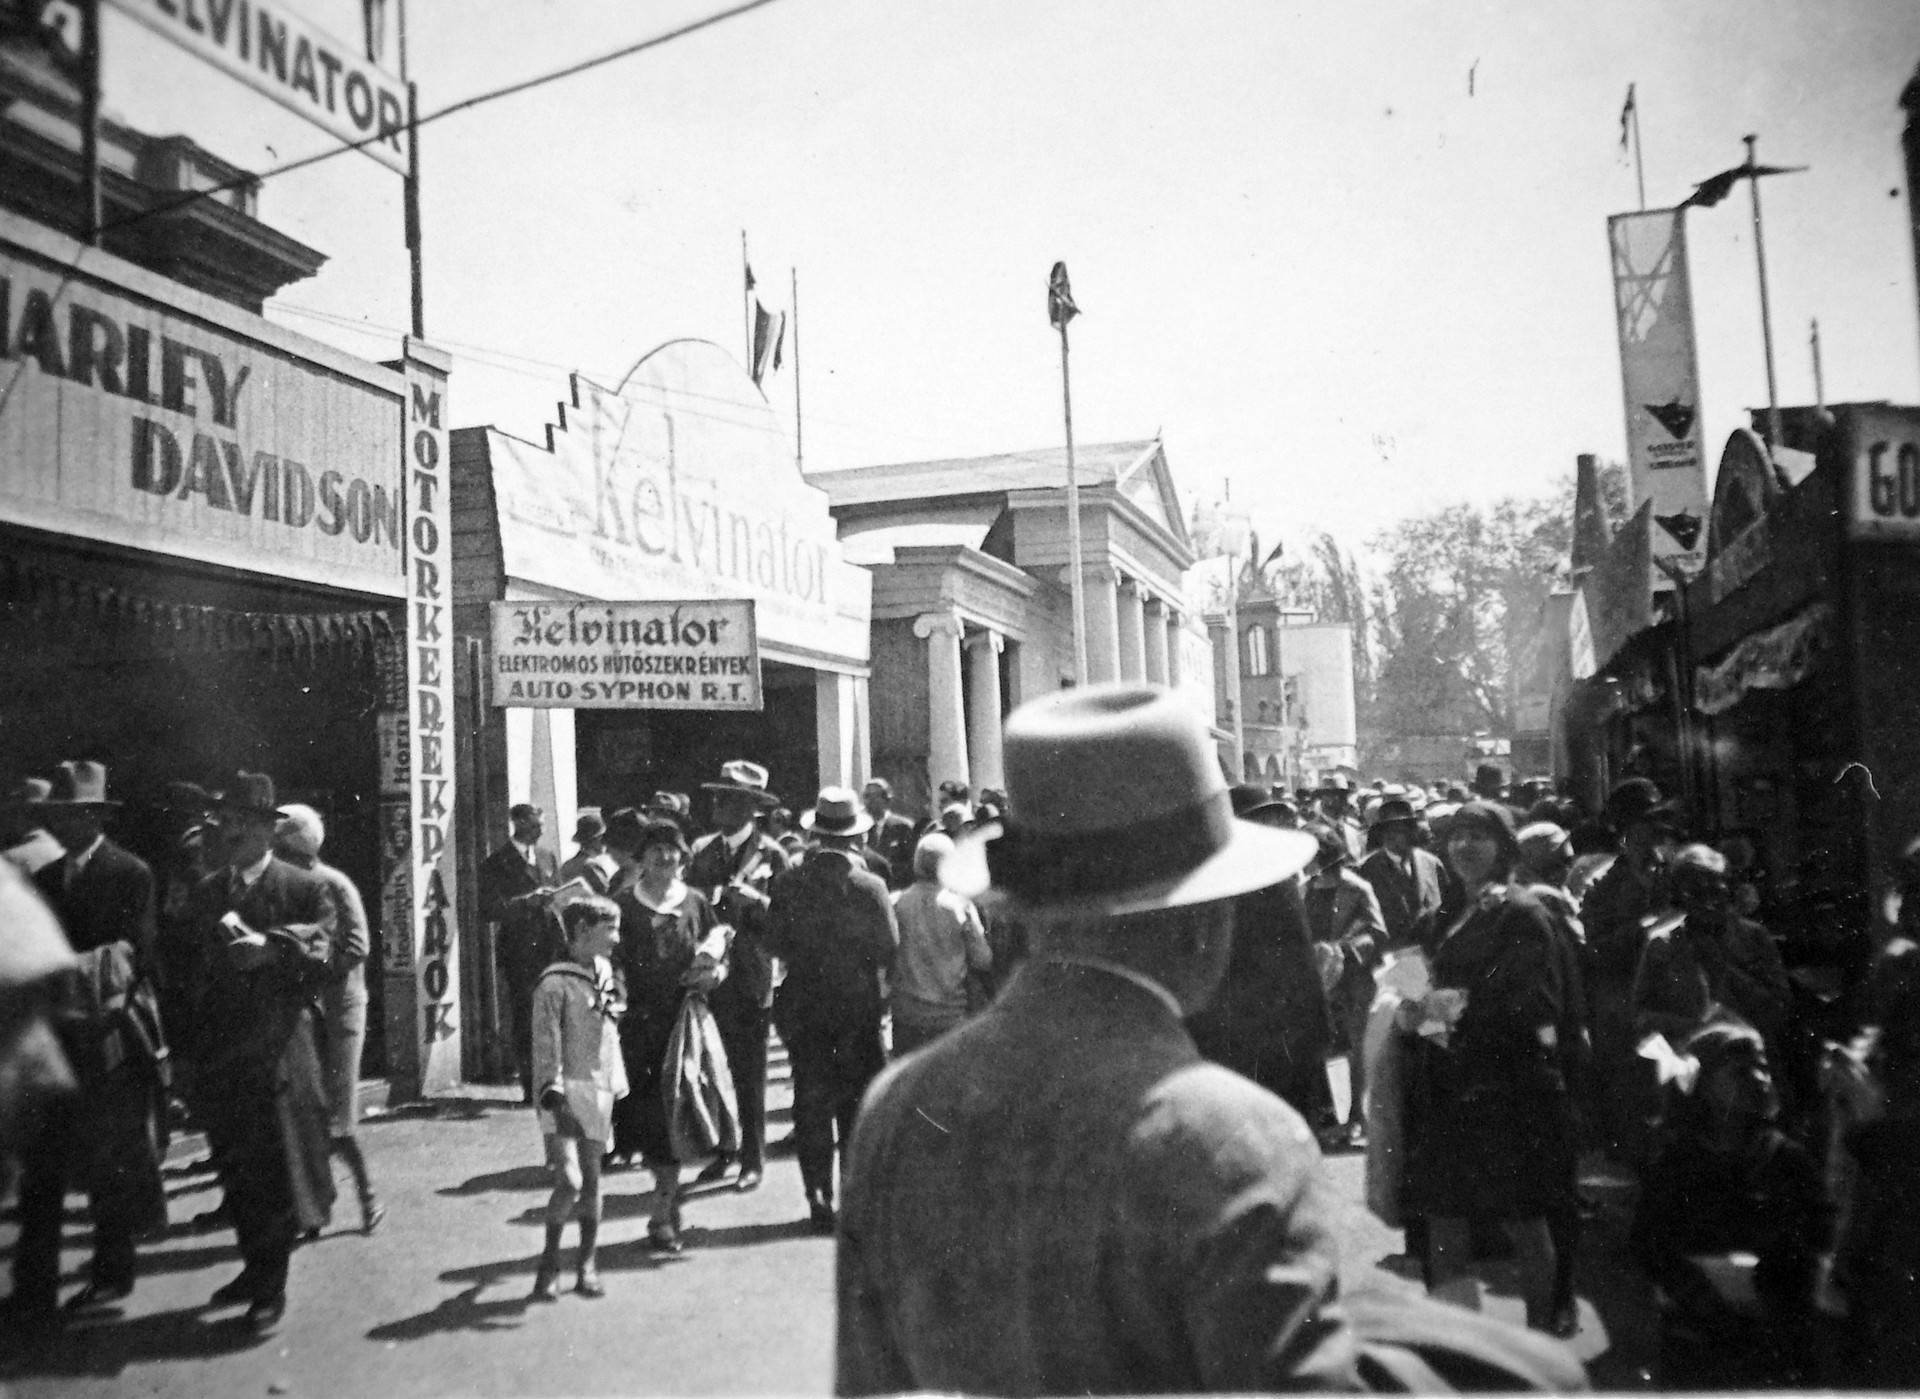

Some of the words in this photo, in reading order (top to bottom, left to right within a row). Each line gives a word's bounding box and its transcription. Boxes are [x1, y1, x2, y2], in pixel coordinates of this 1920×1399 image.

[0, 276, 251, 429] ARLEY
[131, 415, 399, 550] DAVIDSON
[586, 393, 829, 605] Kelvinator
[499, 655, 598, 674] ELEKTROMOS
[513, 600, 730, 648] Kelvinator
[509, 680, 573, 699] AUTO
[581, 680, 691, 700] SYPHON
[701, 682, 747, 700] R.T.
